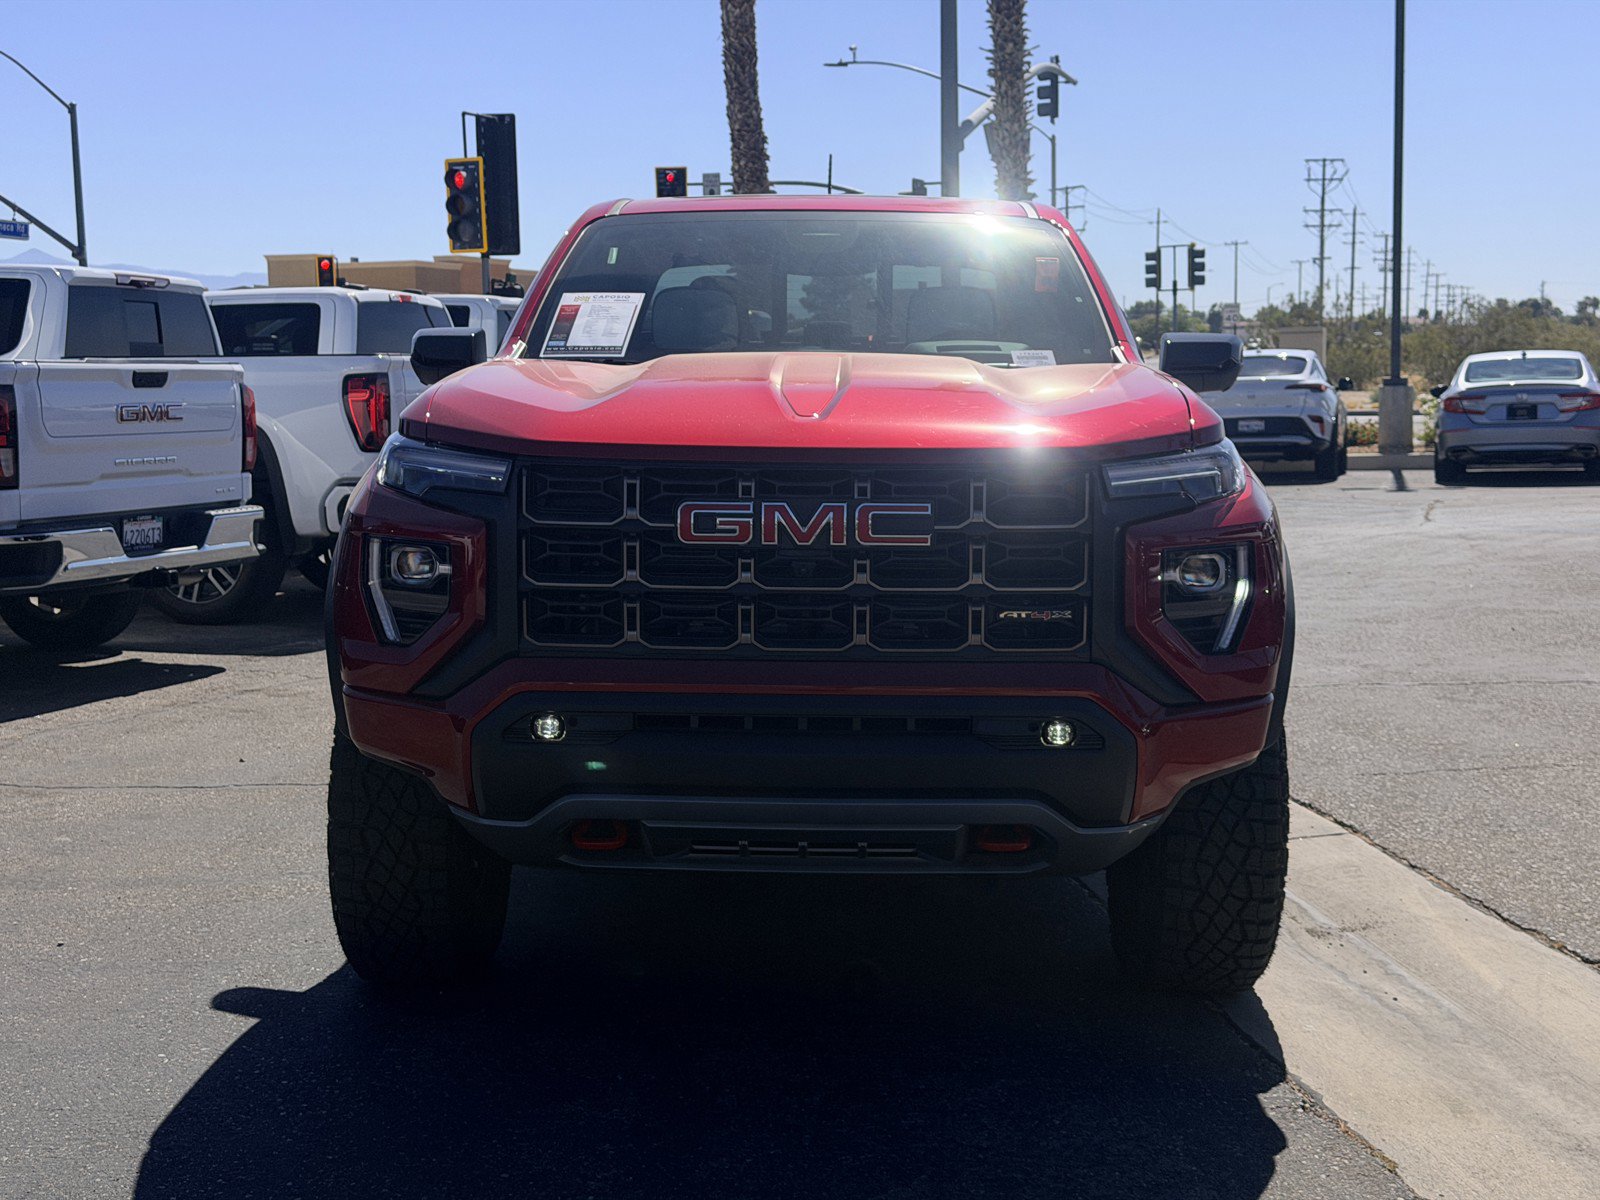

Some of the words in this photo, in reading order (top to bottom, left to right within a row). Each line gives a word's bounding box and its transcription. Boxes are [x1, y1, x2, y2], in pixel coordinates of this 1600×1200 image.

[115, 402, 186, 424] GMC
[115, 455, 177, 466] SIERRA
[677, 501, 932, 546] GMC
[999, 610, 1072, 621] AT4X
